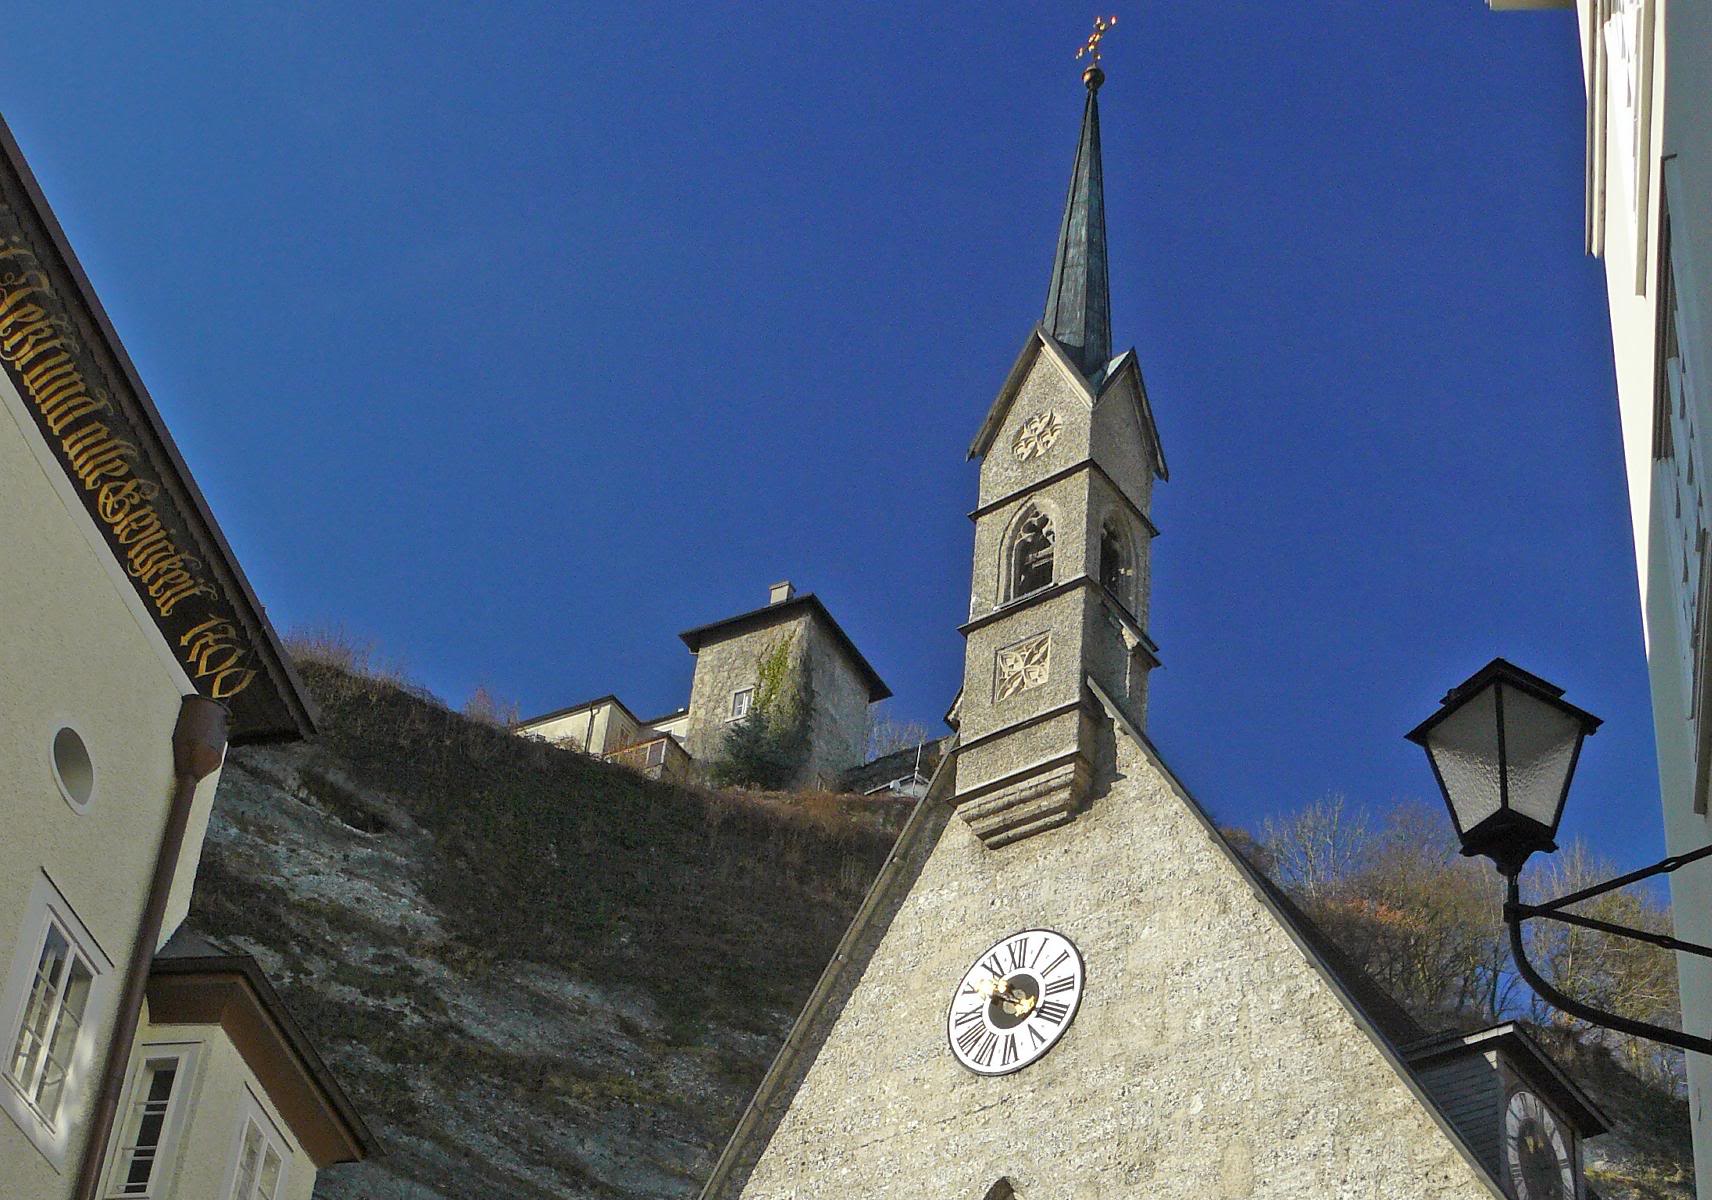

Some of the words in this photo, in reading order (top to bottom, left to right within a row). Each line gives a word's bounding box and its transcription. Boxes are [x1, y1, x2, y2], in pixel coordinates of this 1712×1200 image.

[23, 351, 114, 436] und
[62, 421, 138, 490] alle
[98, 478, 218, 617] Ewigkeit
[179, 613, 257, 699] 1700
[980, 951, 1007, 979] XI
[1006, 937, 1030, 973] XII
[1029, 937, 1049, 969] I
[1040, 949, 1071, 979] II
[1045, 973, 1075, 997] III
[955, 1003, 985, 1029] IX
[1035, 999, 1071, 1027] IIII
[956, 1021, 988, 1057] VIII
[972, 1032, 999, 1067] VII
[1000, 1033, 1020, 1066] VI
[1027, 1023, 1048, 1050] V
